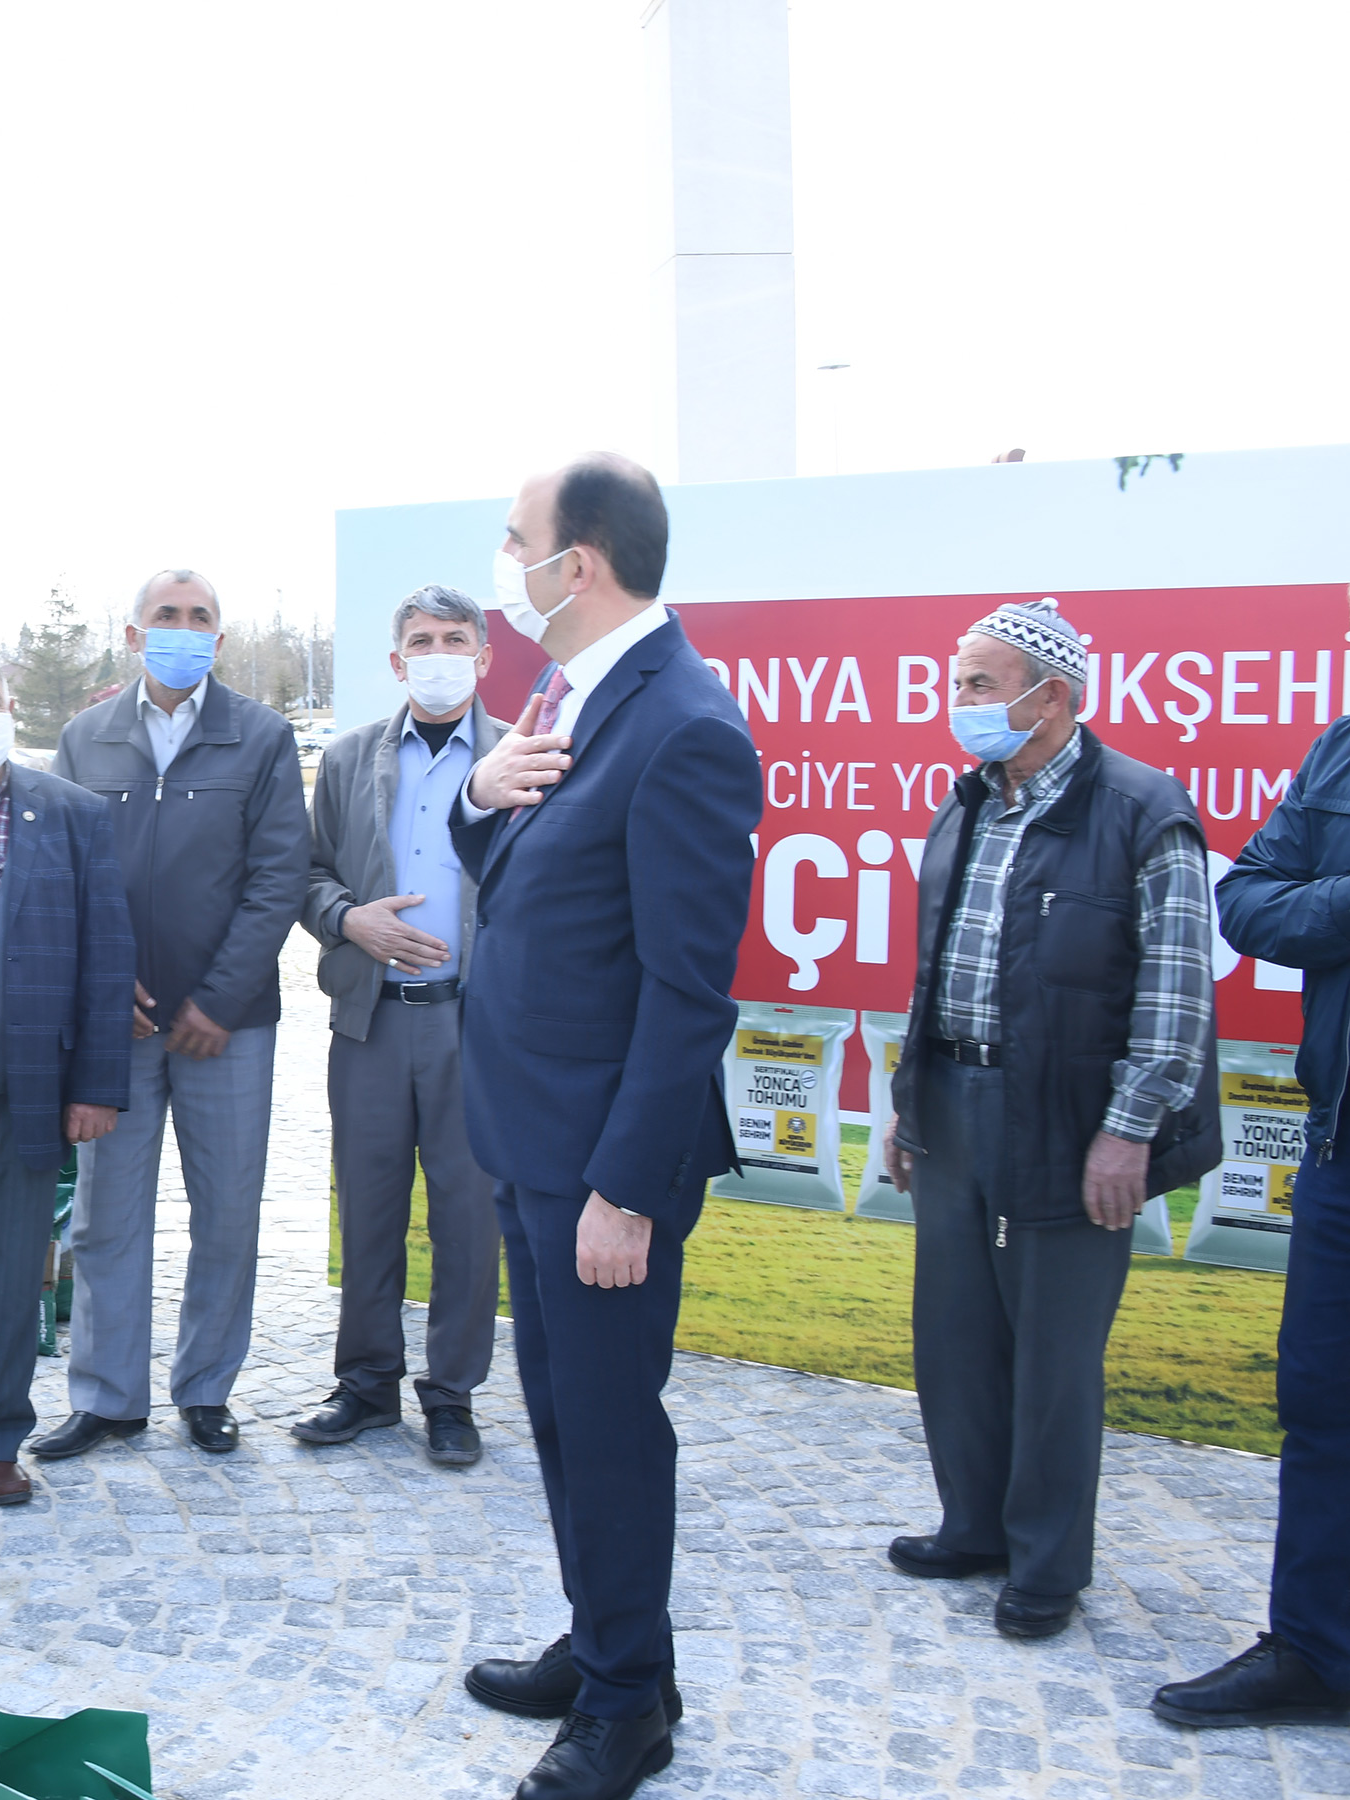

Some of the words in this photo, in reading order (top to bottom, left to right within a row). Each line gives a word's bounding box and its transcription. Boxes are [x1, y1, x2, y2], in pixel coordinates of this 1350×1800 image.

[702, 656, 872, 723] NYA
[755, 749, 877, 811] CİYE
[892, 763, 976, 813] YO
[753, 1074, 802, 1093] YONCA
[747, 1088, 808, 1109] TOHUMU
[1241, 1123, 1303, 1145] YONCA
